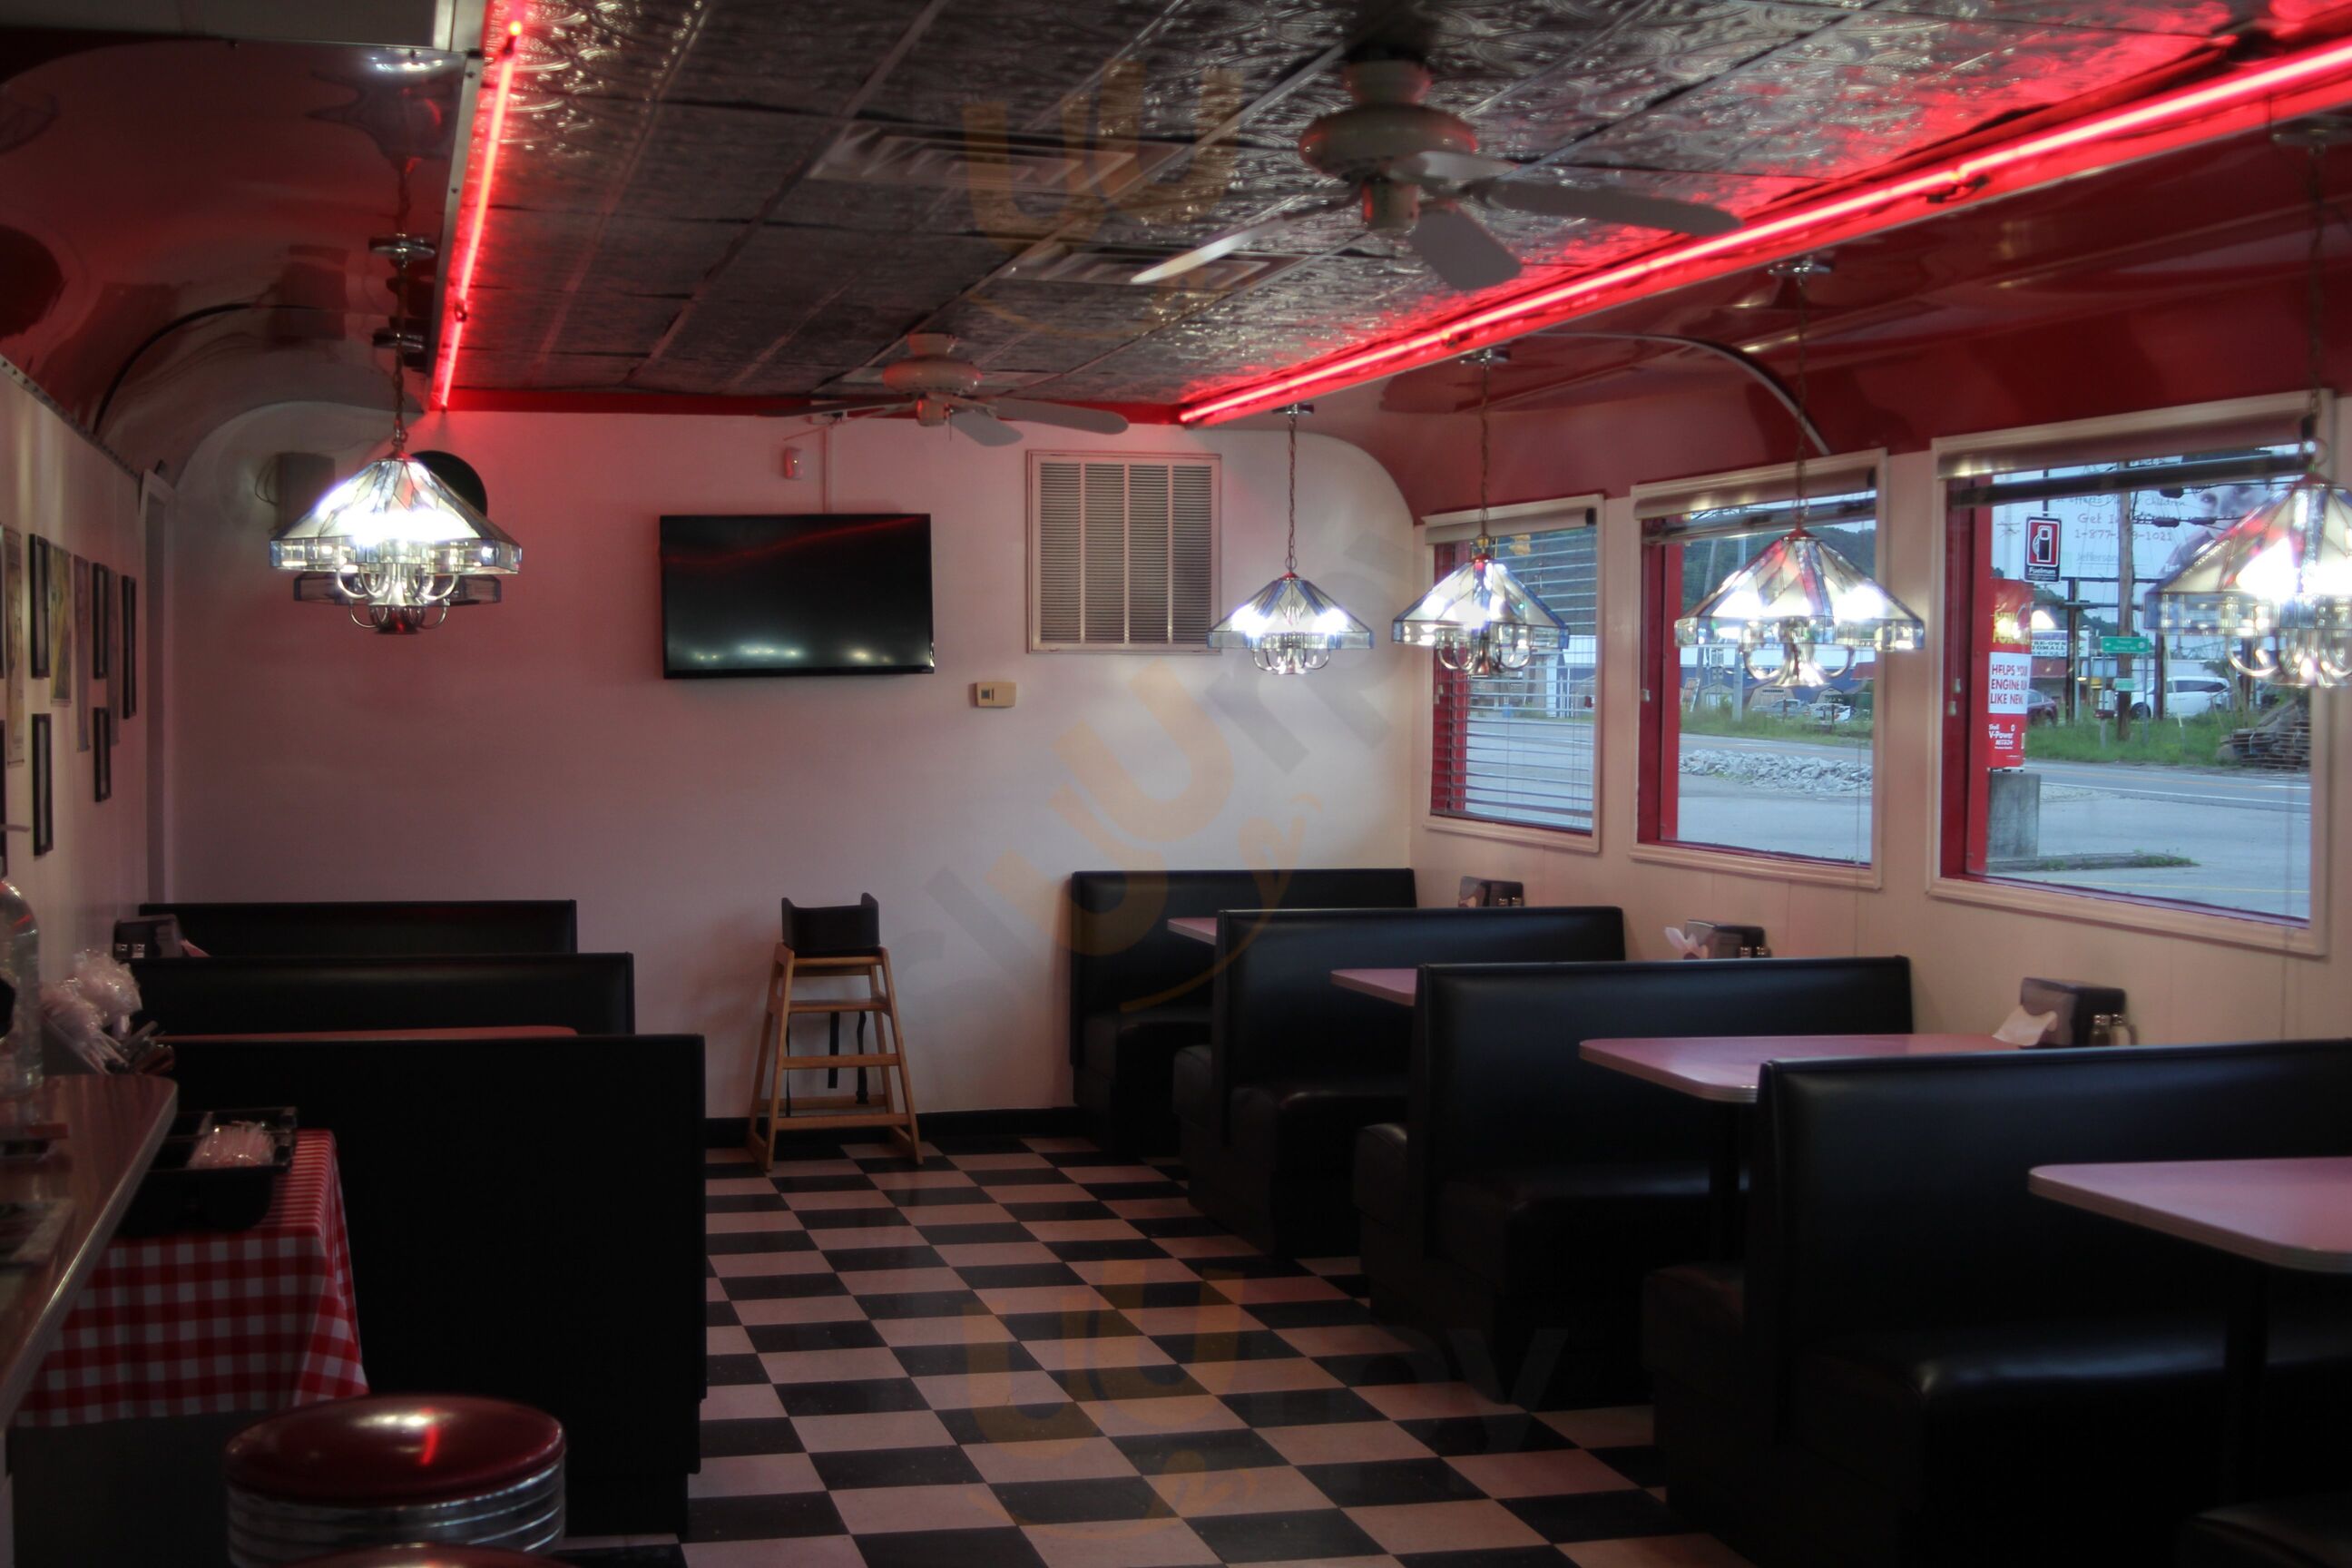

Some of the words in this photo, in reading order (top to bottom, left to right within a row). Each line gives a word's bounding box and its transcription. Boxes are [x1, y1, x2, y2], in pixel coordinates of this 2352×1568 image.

[2077, 513, 2102, 524] Get
[1992, 664, 2015, 676] HELPS
[1991, 679, 2019, 690] ENGINE
[1990, 693, 2007, 704] LIKE
